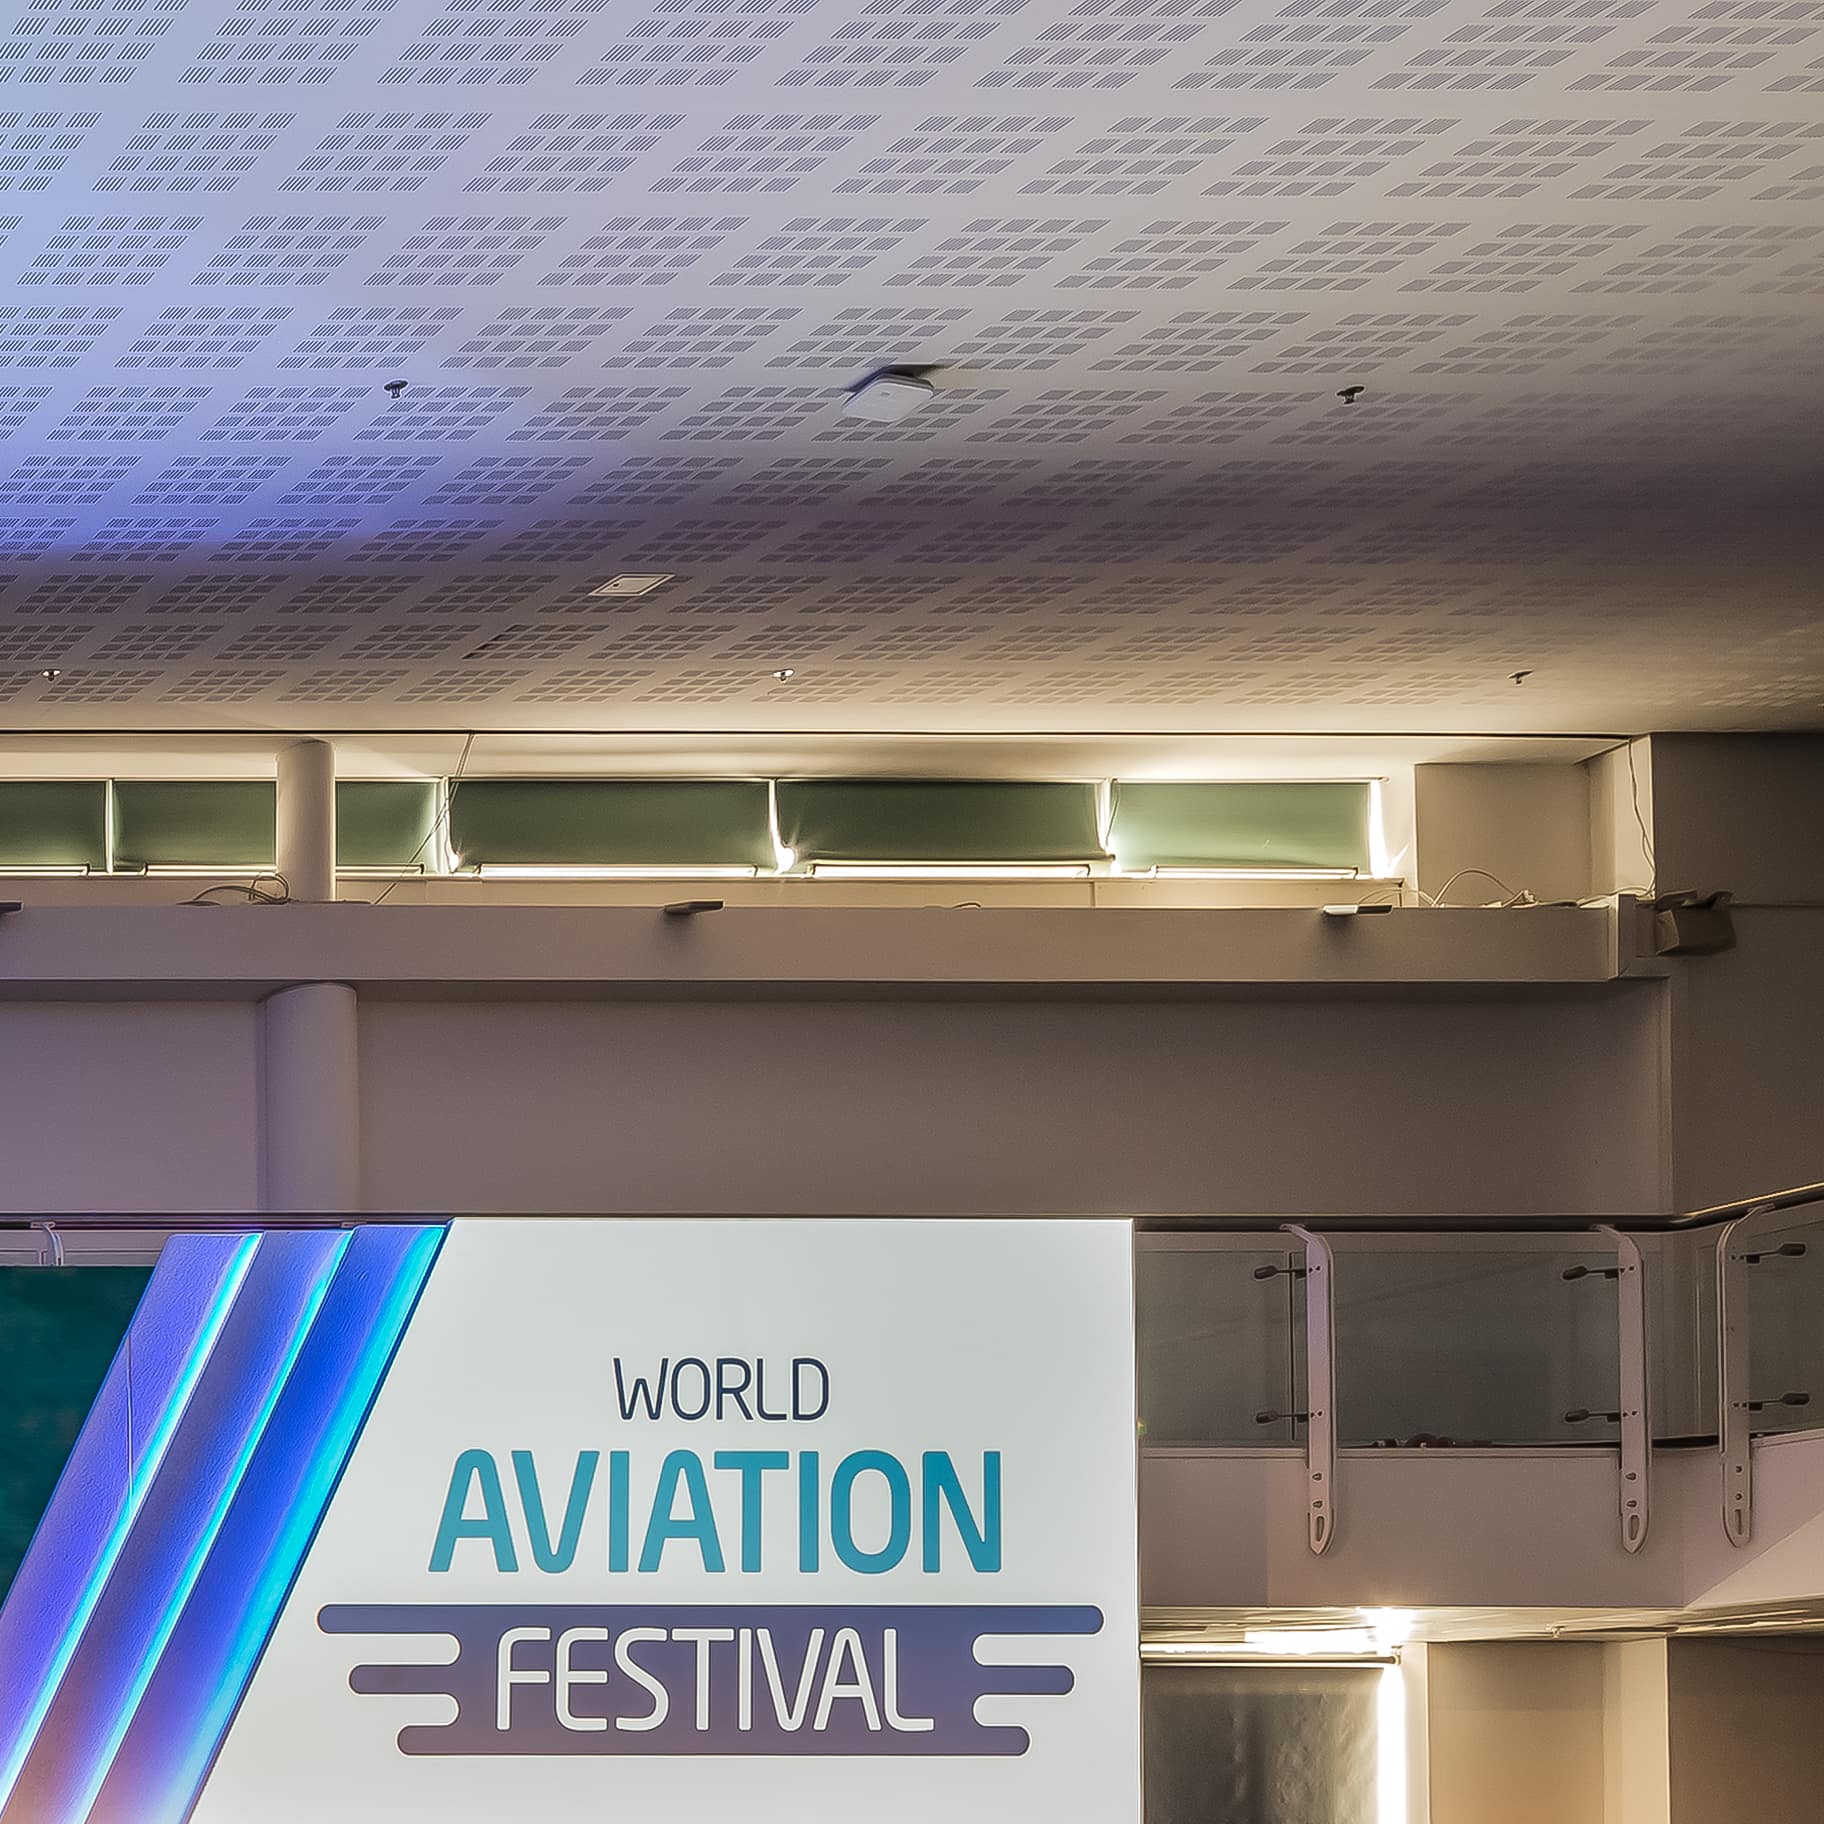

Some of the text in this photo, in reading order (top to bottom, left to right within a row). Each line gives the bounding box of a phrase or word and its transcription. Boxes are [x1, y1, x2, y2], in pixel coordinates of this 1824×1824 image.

[613, 1357, 830, 1421] WORLD
[427, 1448, 1002, 1574] AVIATION
[496, 1626, 936, 1732] FESTIVAL
